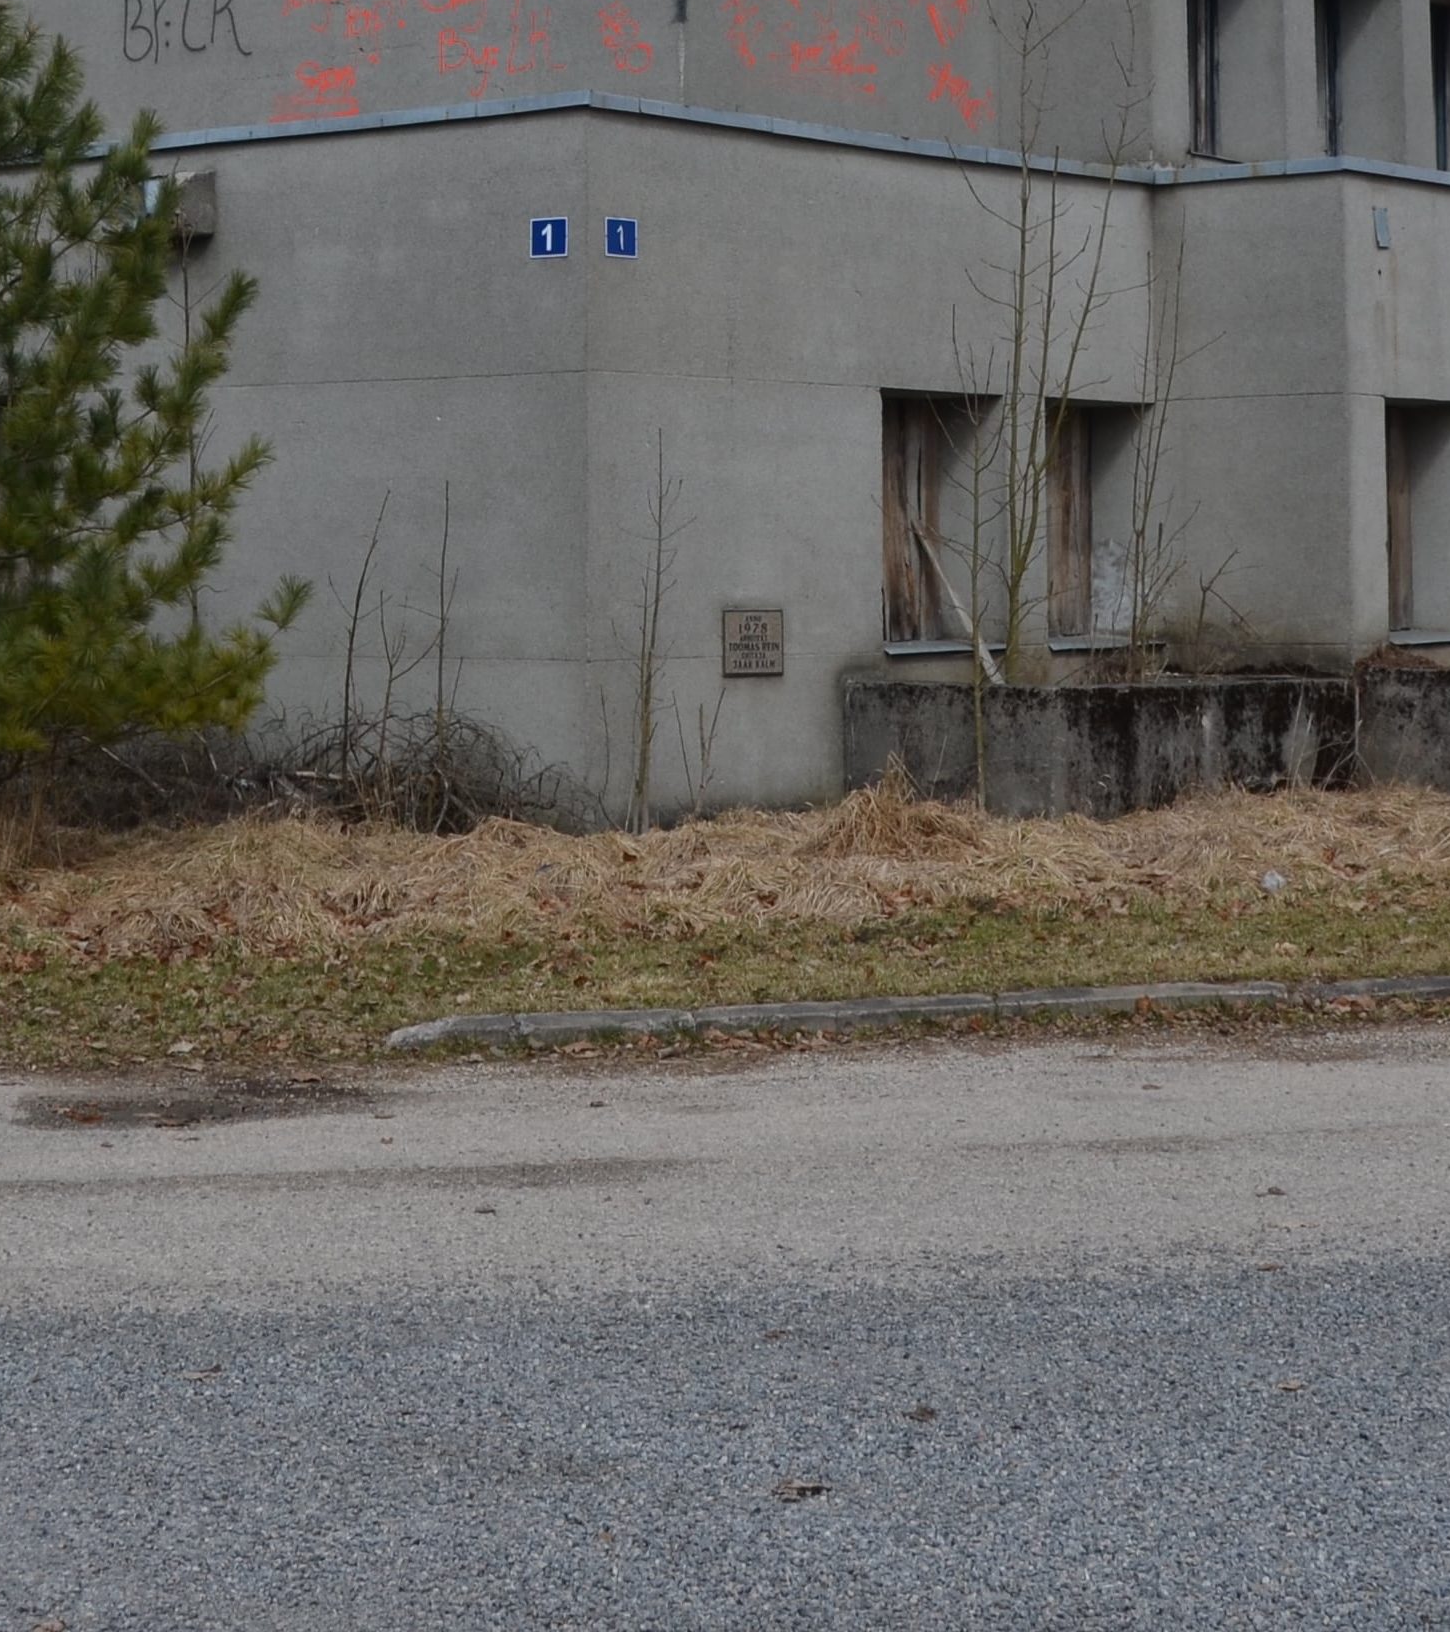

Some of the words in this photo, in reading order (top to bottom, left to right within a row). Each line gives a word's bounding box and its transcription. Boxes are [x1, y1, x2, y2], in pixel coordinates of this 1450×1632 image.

[541, 223, 553, 252] 1
[617, 225, 624, 251] 1
[738, 623, 768, 634] 1978
